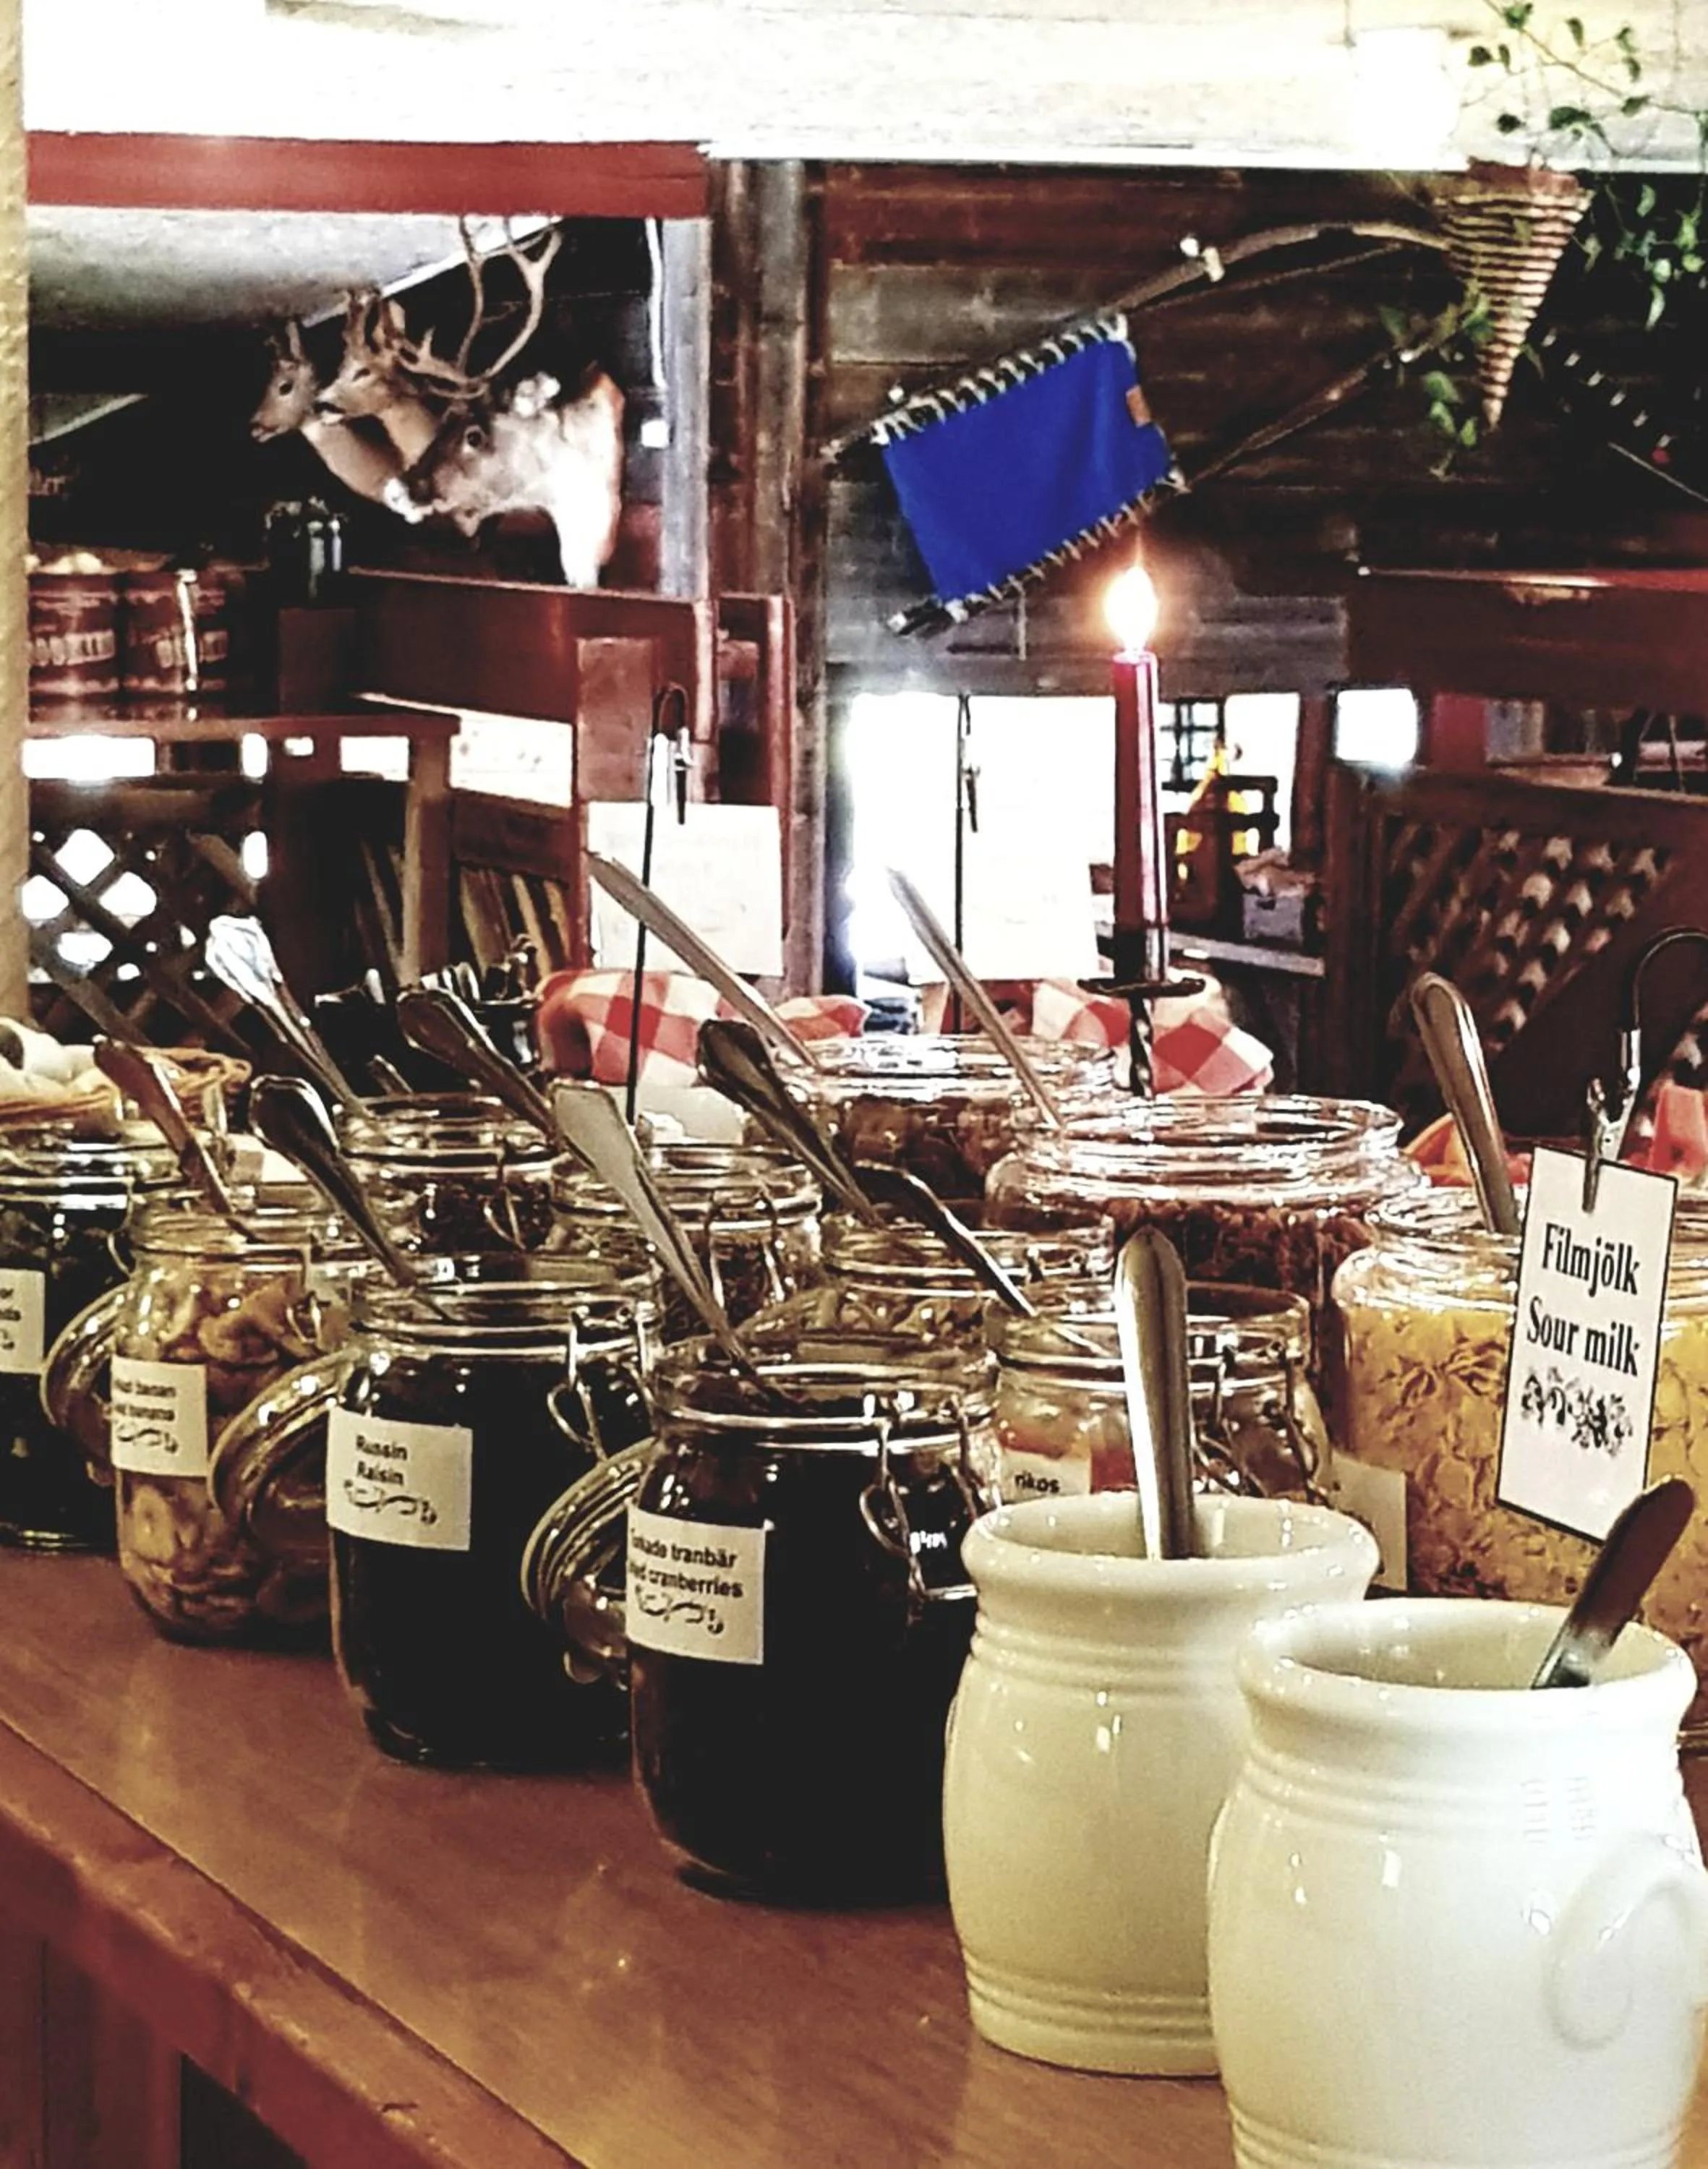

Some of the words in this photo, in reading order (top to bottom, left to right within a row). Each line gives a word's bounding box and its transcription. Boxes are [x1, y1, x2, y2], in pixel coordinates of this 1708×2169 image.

[1542, 1223, 1640, 1298] Filmjölk
[1526, 1296, 1579, 1356] Sour
[1584, 1322, 1641, 1377] milk
[670, 1543, 738, 1569] tranbär
[648, 1570, 744, 1599] cranberries
